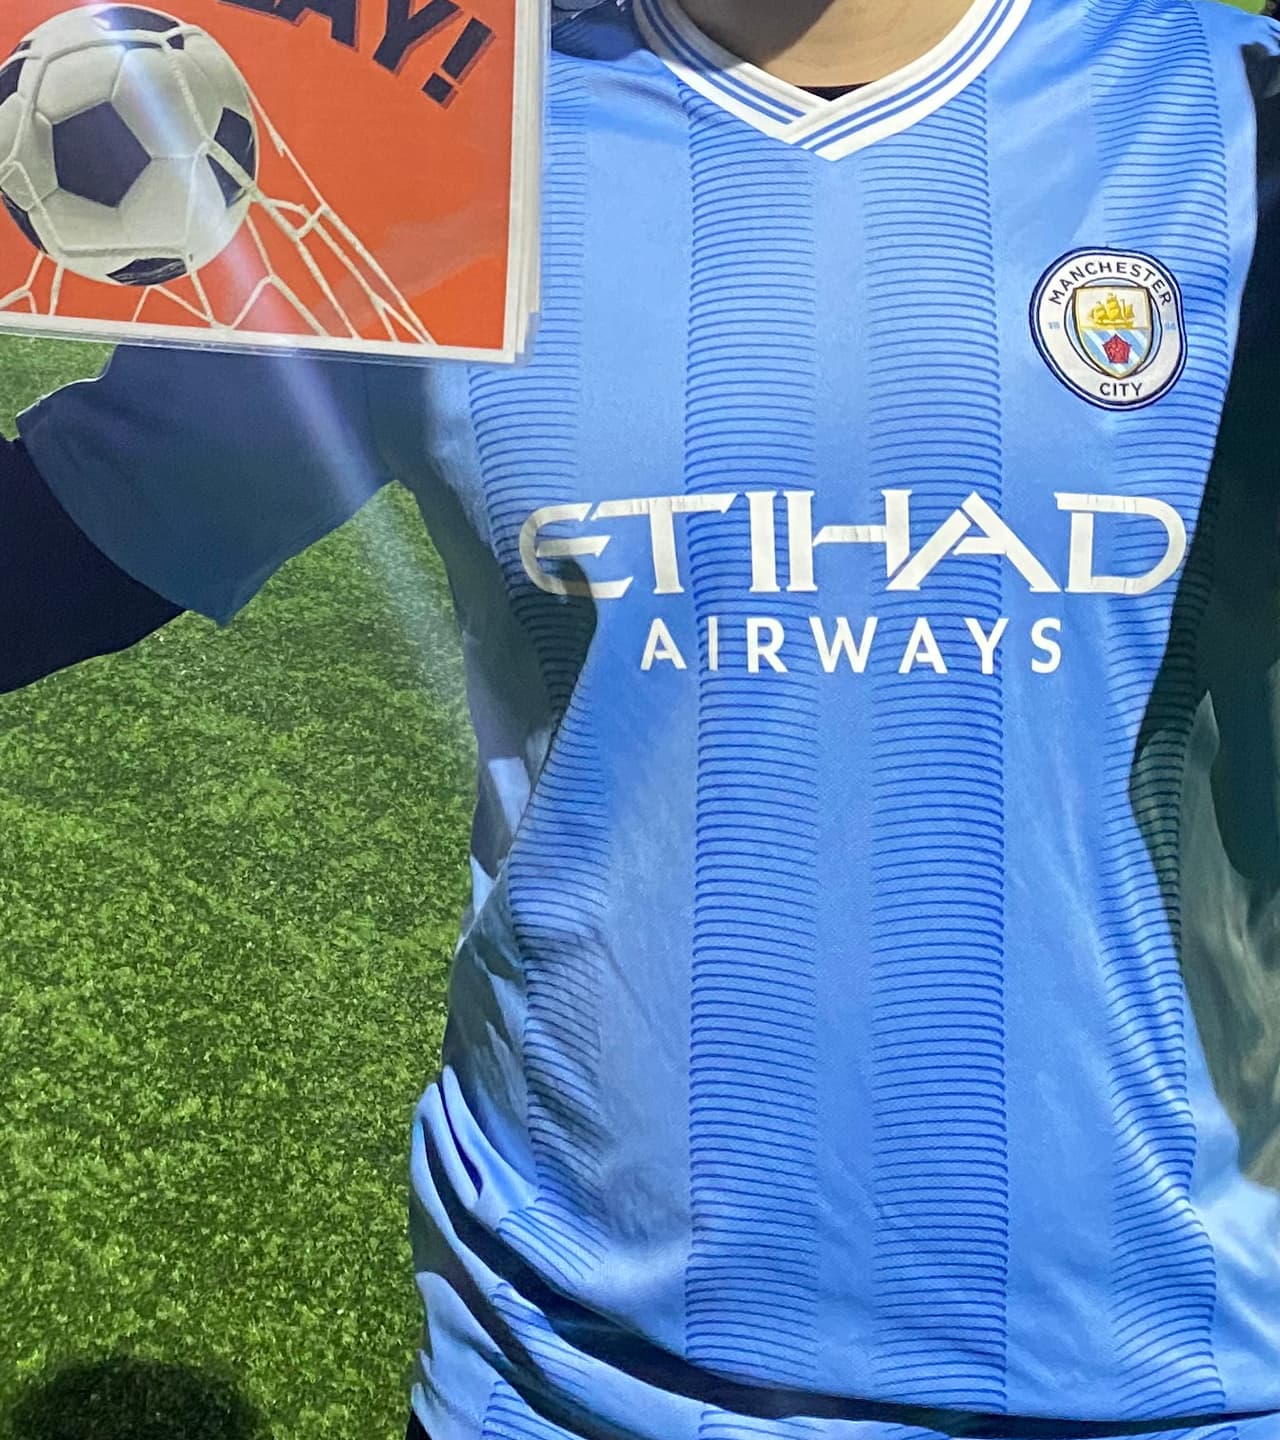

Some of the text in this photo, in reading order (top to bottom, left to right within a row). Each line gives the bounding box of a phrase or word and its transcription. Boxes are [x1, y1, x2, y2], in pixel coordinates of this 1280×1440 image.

[1048, 261, 1172, 307] MANCHESTER
[1098, 382, 1143, 398] CITY
[519, 489, 1188, 600] ETIHAD
[641, 616, 1064, 676] AIRWAYS
